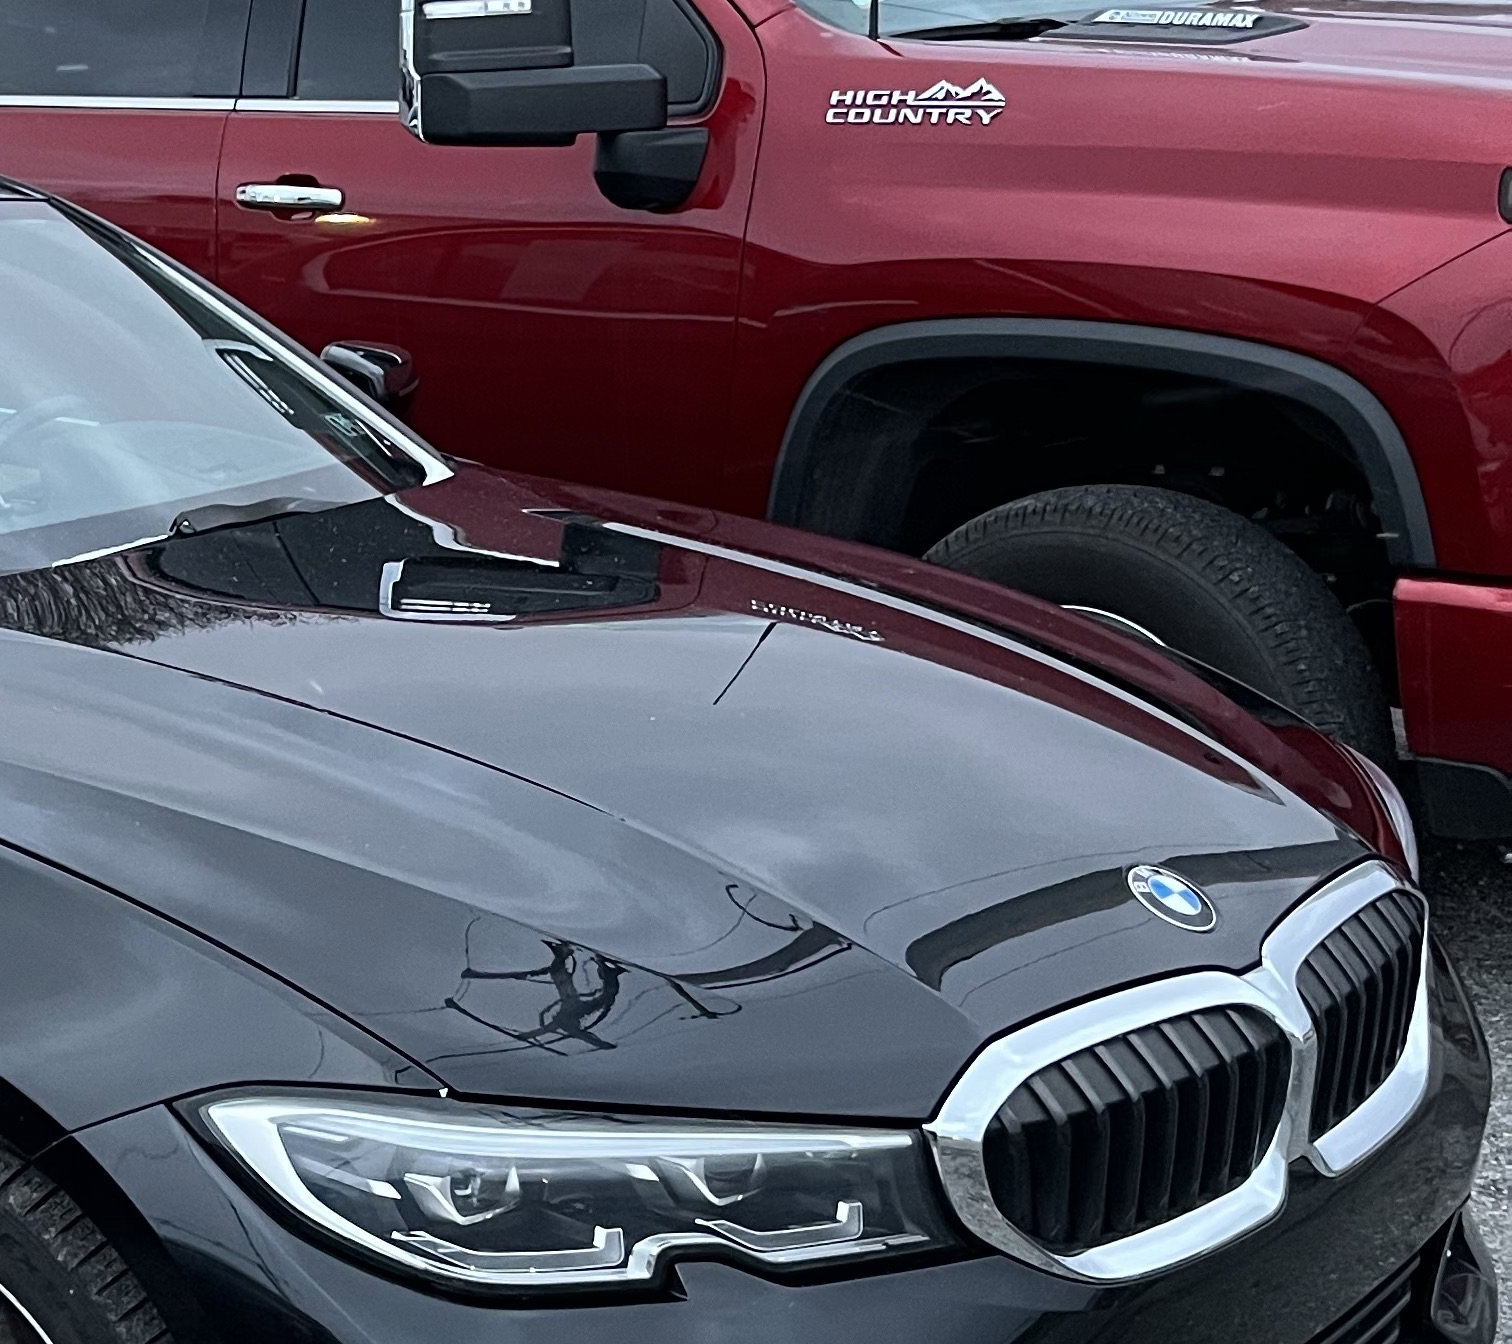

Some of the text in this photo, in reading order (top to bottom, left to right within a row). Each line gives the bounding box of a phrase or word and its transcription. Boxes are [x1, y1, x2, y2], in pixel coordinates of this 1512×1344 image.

[1158, 10, 1262, 29] DURAMAX
[829, 89, 916, 106] HIGH
[825, 107, 1004, 125] COUNTRY
